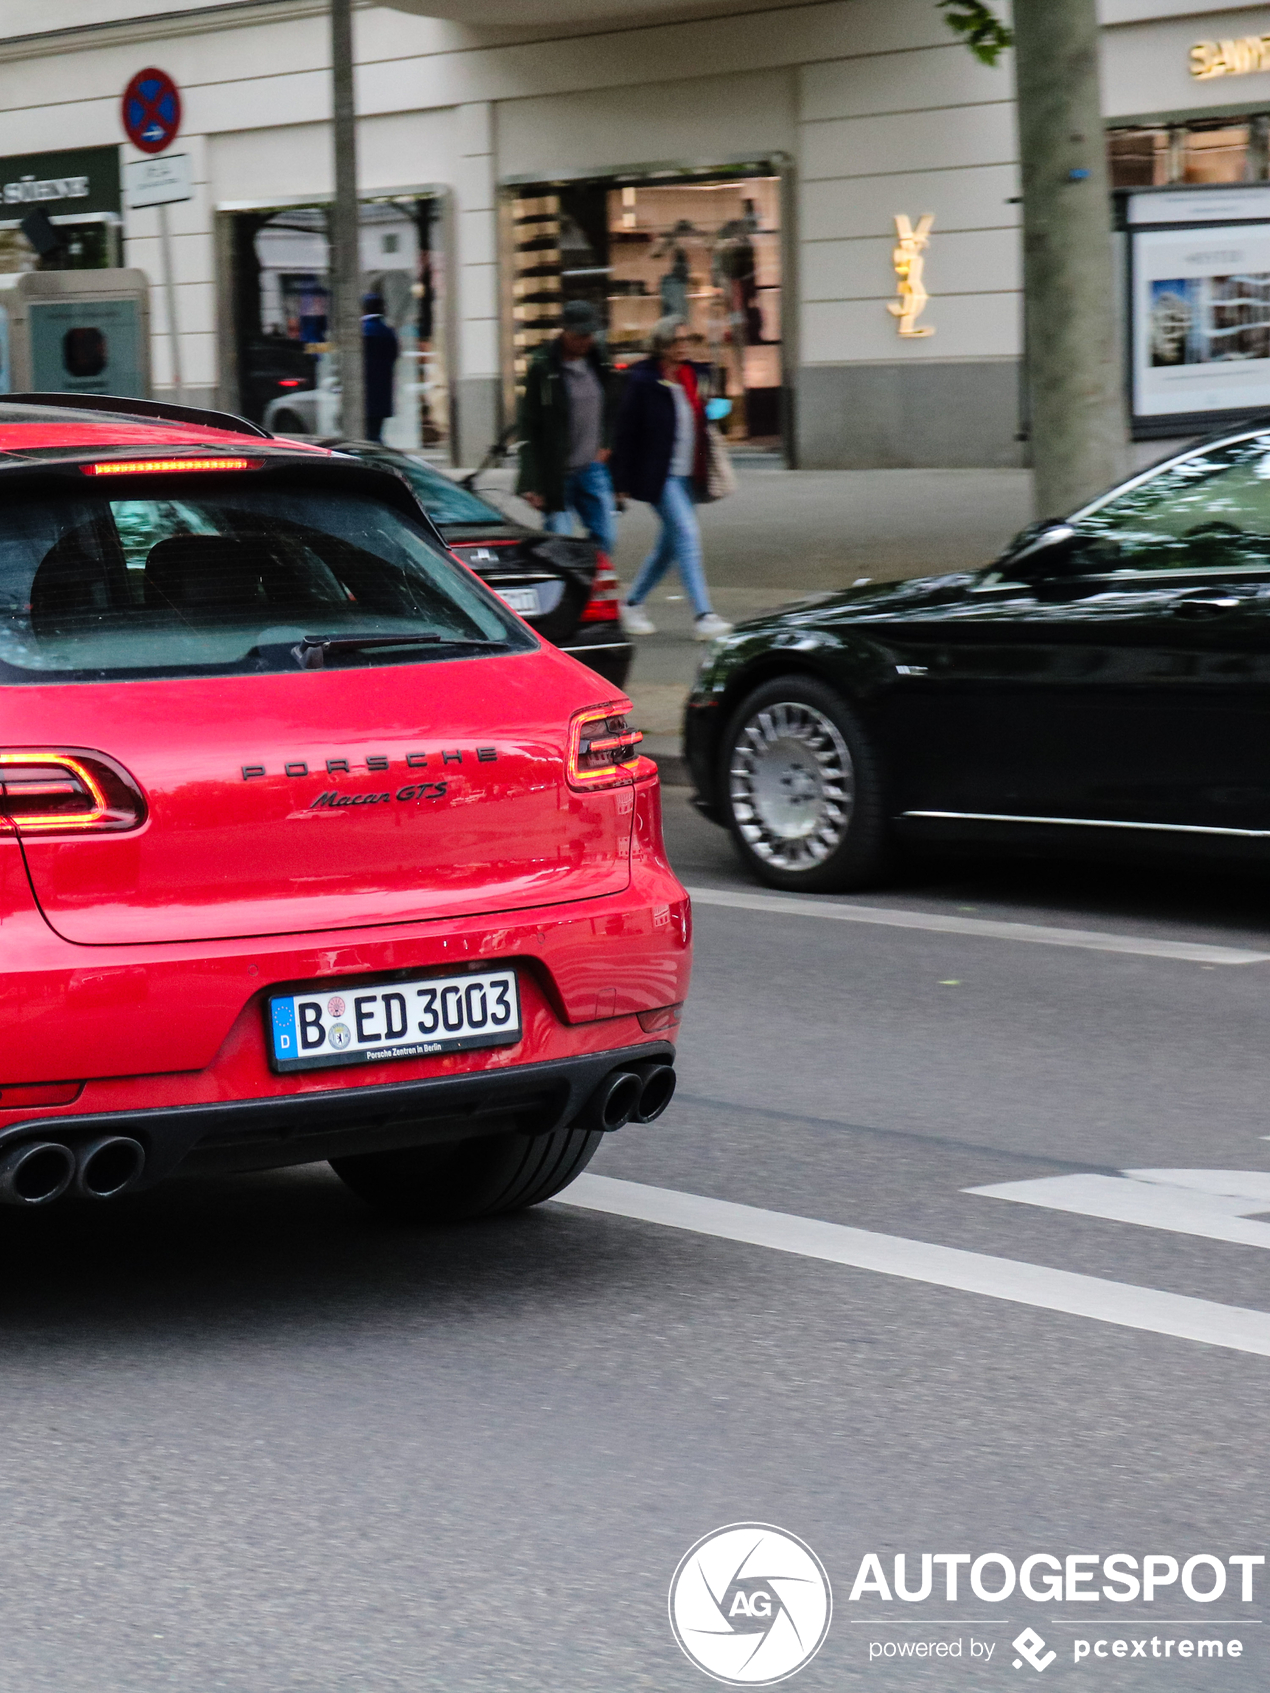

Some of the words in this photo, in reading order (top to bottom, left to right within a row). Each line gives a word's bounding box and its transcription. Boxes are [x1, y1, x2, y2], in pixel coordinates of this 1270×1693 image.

[2, 174, 90, 204] SÖHNE
[241, 746, 498, 781] PORSCHE
[310, 791, 391, 808] Macan
[395, 781, 448, 801] GTS
[280, 1035, 291, 1049] D
[298, 1001, 327, 1050] B
[354, 992, 409, 1044] ED
[416, 979, 512, 1035] 3003
[366, 1049, 392, 1060] Porsche
[392, 1047, 416, 1056] Zentren
[417, 1045, 423, 1053] in
[424, 1043, 442, 1052] Berlin
